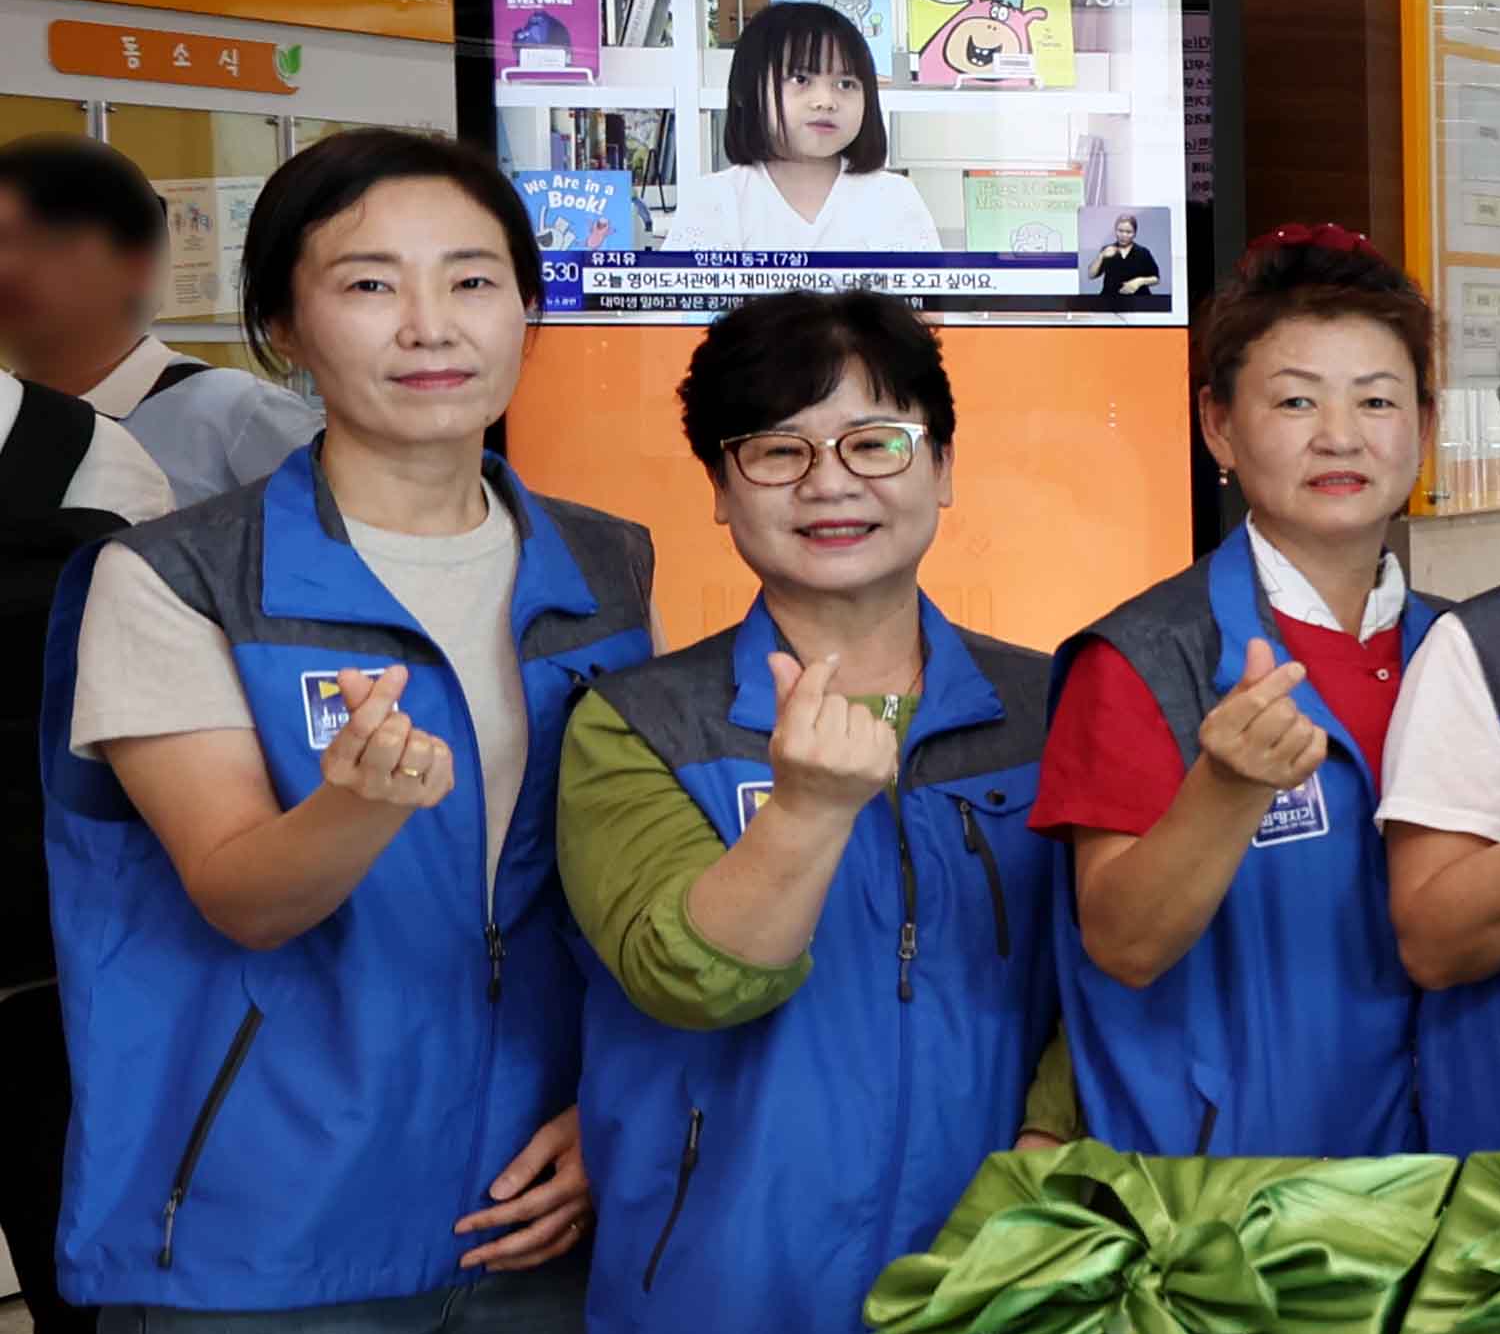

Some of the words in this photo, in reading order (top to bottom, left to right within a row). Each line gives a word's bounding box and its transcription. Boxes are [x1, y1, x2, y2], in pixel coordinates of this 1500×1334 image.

[524, 177, 548, 195] We
[552, 174, 580, 189] Are
[584, 174, 601, 194] in
[604, 185, 615, 196] a
[548, 190, 609, 216] Book!
[591, 252, 637, 266] 유지유
[694, 252, 738, 267] 인천시
[743, 252, 769, 267] 동구
[773, 252, 809, 267] (7살)
[541, 261, 580, 284] 530
[592, 272, 622, 289] 오늘
[627, 272, 736, 289] 영어도서관에서
[893, 273, 908, 289] 또
[911, 273, 943, 289] 오고
[947, 273, 998, 290] 싶어요.
